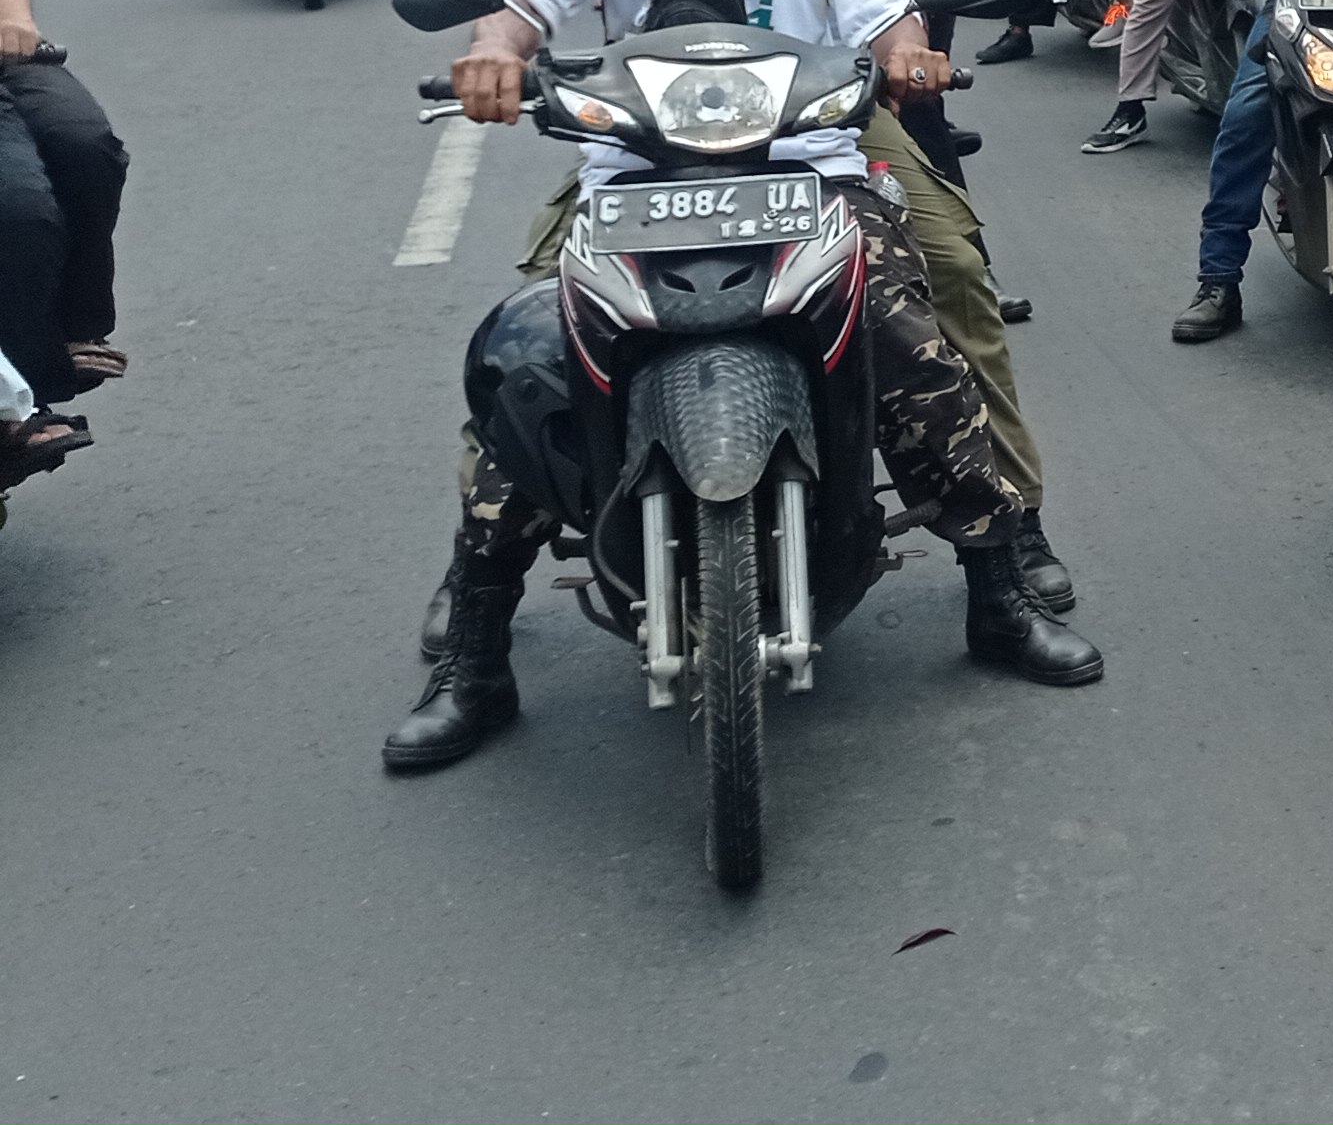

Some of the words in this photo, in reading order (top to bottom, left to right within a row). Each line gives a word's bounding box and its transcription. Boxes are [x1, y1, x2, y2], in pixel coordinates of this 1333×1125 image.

[684, 41, 751, 52] HONDA
[600, 195, 622, 224] G
[649, 185, 738, 220] 3884
[767, 182, 812, 212] UA
